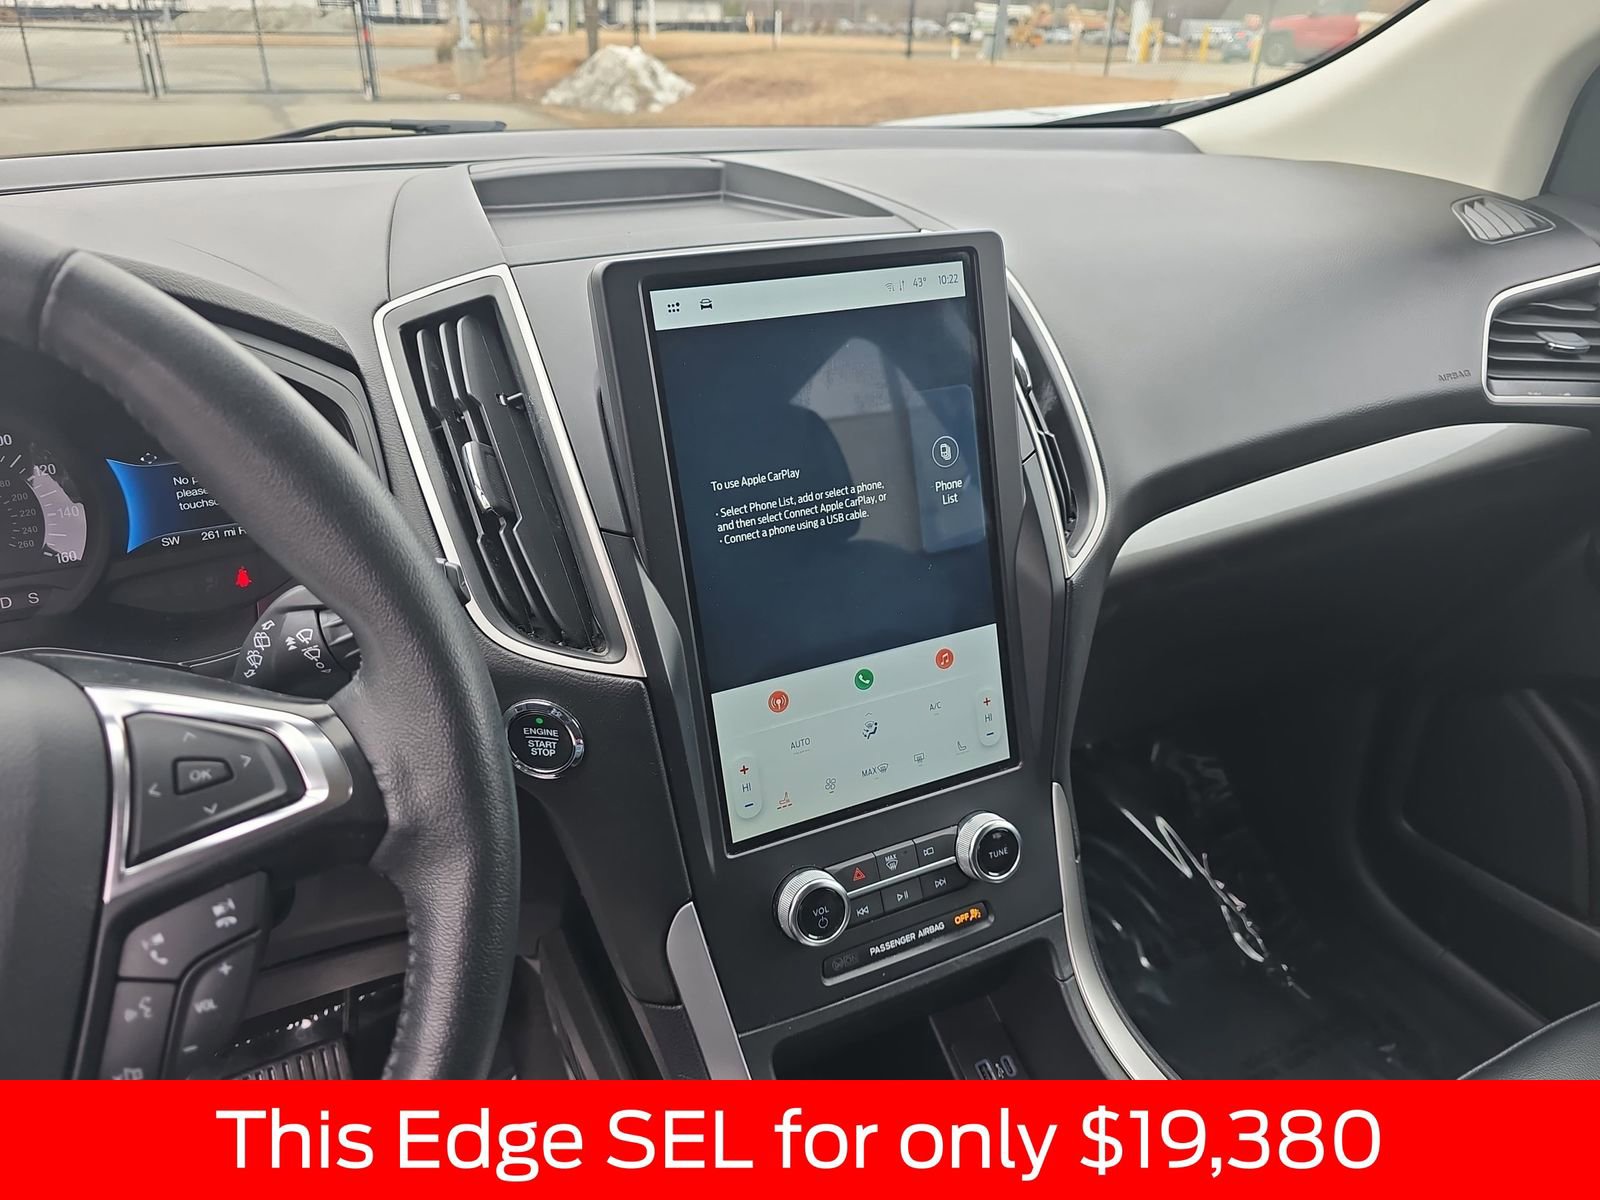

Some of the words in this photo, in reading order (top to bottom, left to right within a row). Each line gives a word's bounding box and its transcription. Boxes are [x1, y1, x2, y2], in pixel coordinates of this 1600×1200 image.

[913, 277, 926, 288] 43°
[938, 274, 958, 285] 10:22
[1438, 369, 1471, 381] AIRBAG
[34, 464, 56, 476] 120
[173, 477, 189, 485] No
[710, 481, 723, 491] To
[724, 480, 740, 490] use
[741, 475, 767, 487] Apple
[767, 469, 800, 482] CarPlay
[935, 480, 963, 492] Phone
[11, 493, 28, 502] 200
[720, 504, 748, 518] Select
[749, 500, 778, 513] Phone
[778, 495, 797, 508] List,
[797, 491, 814, 504] add
[814, 491, 824, 501] or
[824, 485, 849, 499] select
[850, 486, 856, 494] a
[856, 481, 885, 495] phone,
[942, 493, 959, 505] List
[19, 508, 36, 517] 220
[57, 505, 80, 519] 140
[717, 520, 735, 533] and
[735, 517, 757, 529] then
[757, 510, 783, 525] select
[783, 504, 819, 520] Connect
[820, 499, 844, 514] Apple
[844, 494, 878, 508] CarPlay,
[878, 493, 887, 502] or
[22, 525, 38, 535] 240
[724, 529, 761, 545] Connect
[761, 529, 768, 538] a
[768, 524, 796, 538] phone
[796, 519, 819, 531] using
[820, 518, 826, 527] a
[826, 512, 844, 525] USB
[845, 508, 870, 521] cable.
[201, 530, 220, 541] 261
[223, 527, 237, 537] mi
[17, 539, 35, 549] 260
[161, 535, 181, 547] SW
[55, 550, 77, 564] 160
[0, 597, 12, 609] D
[28, 592, 40, 604] S
[929, 701, 941, 712] A/C
[984, 713, 993, 723] HI
[523, 728, 559, 737] ENGINE
[528, 740, 557, 749] START
[790, 737, 811, 750] AUTO
[531, 748, 556, 757] STOP
[189, 769, 212, 782] OK
[861, 767, 877, 778] MAX
[742, 782, 752, 793] HI
[885, 854, 897, 862] MAX
[989, 846, 1009, 859] TUNE
[812, 905, 830, 917] VOL
[954, 912, 970, 925] OFF
[869, 932, 916, 957] PASSENGER
[917, 921, 945, 939] AIRBAG
[194, 998, 218, 1013] VOL
